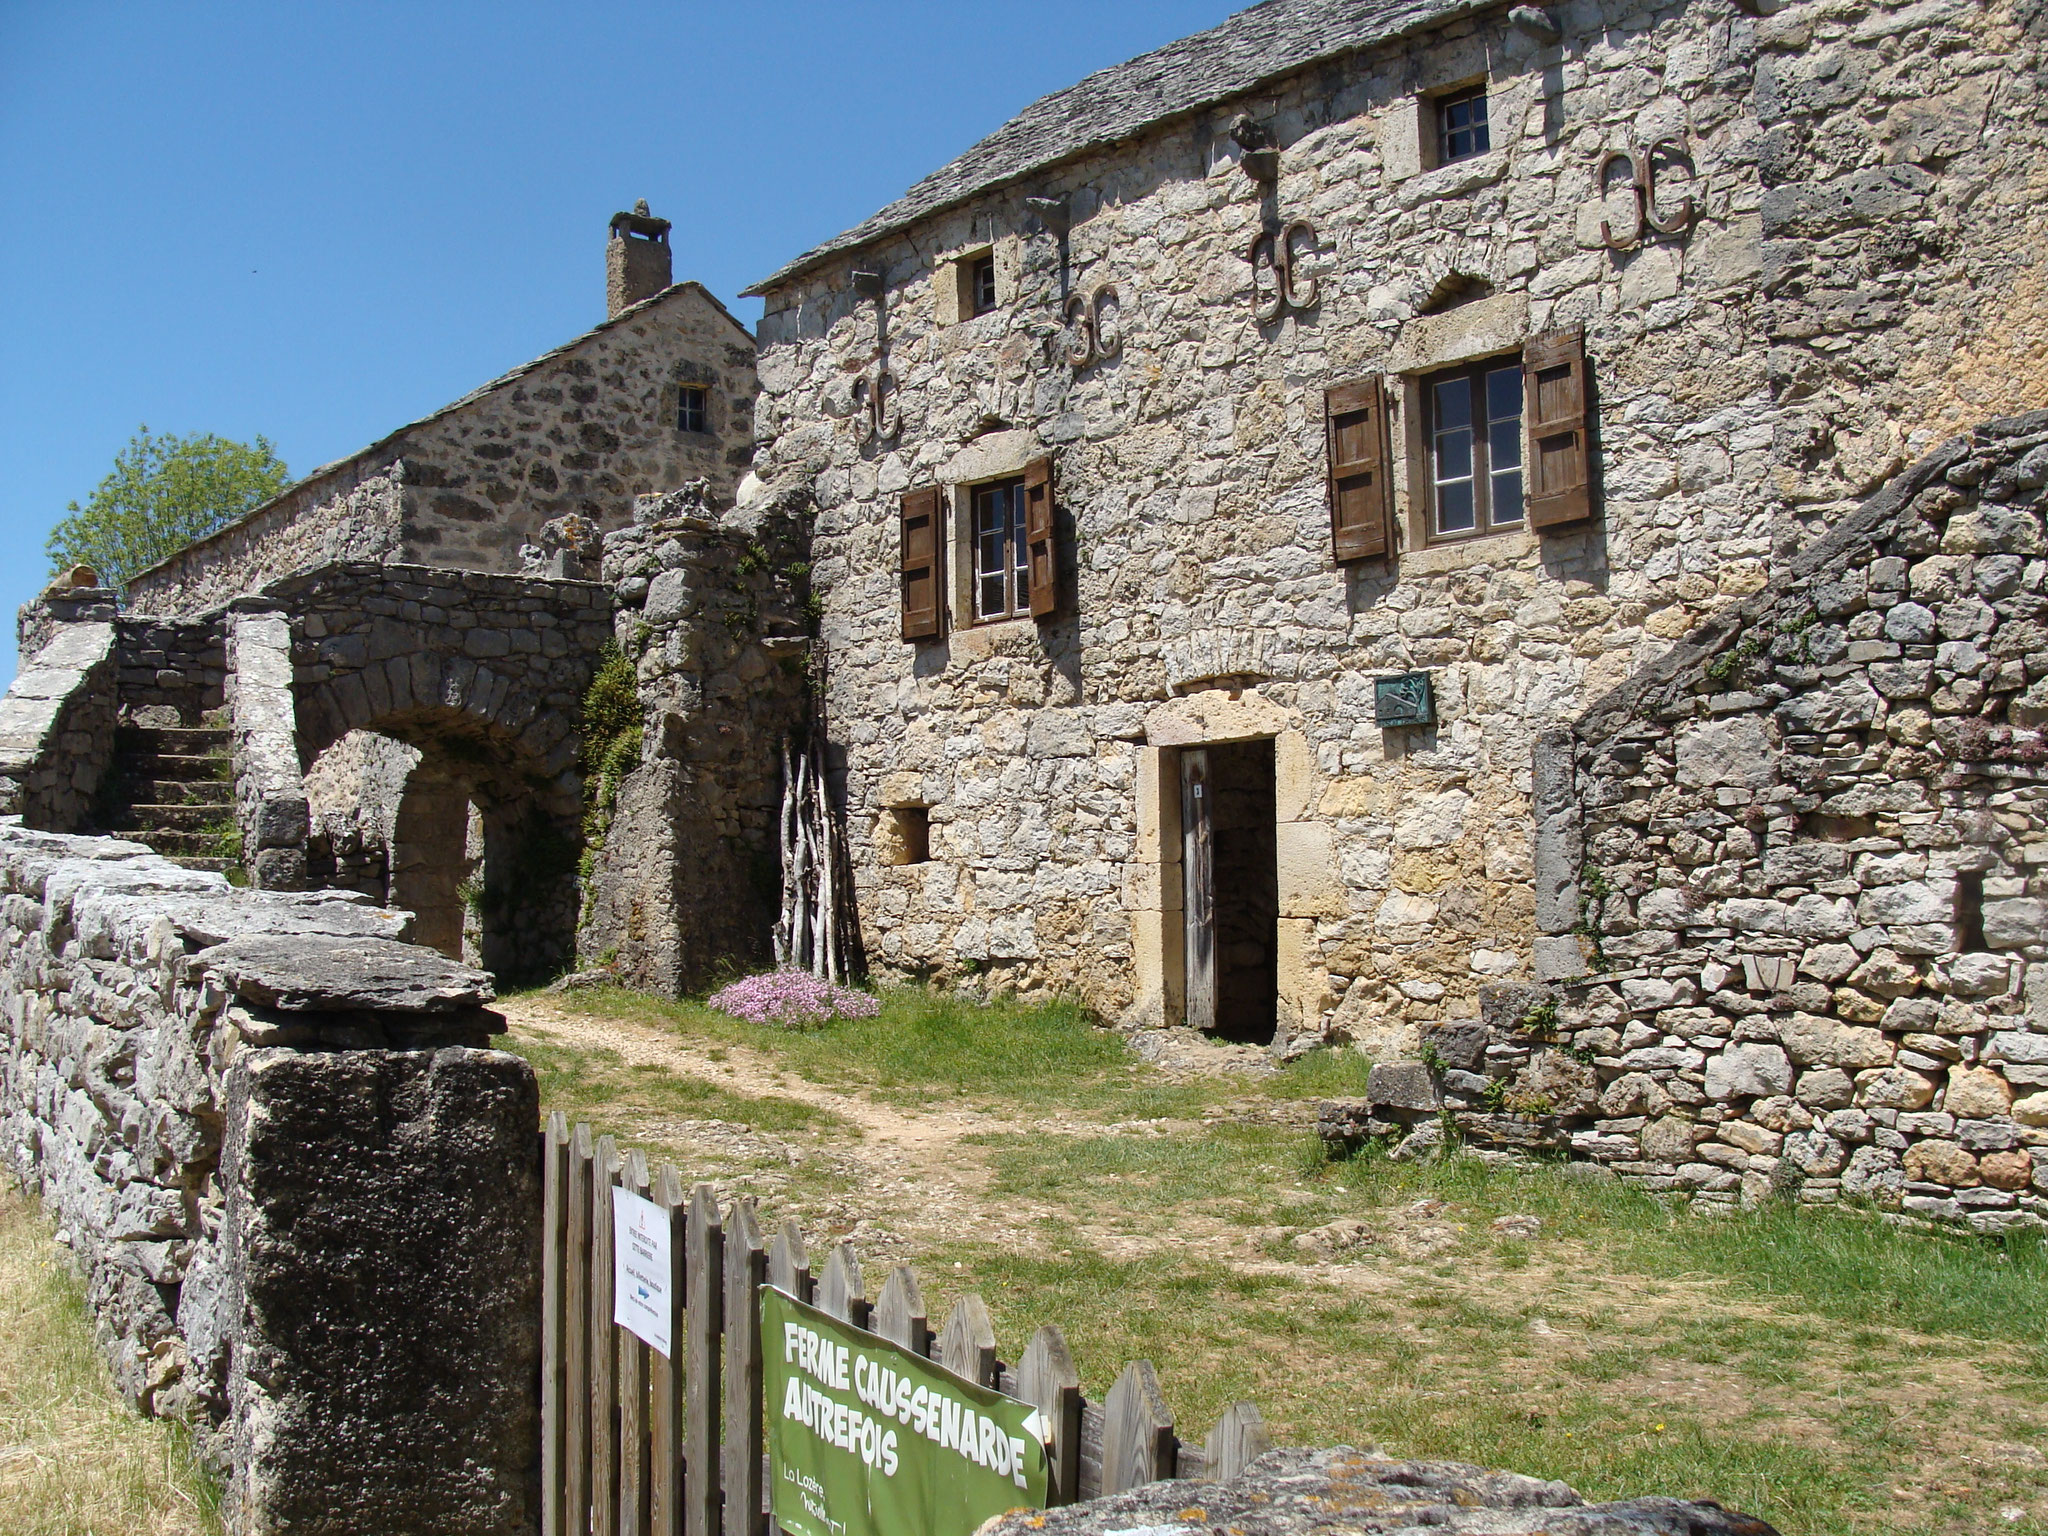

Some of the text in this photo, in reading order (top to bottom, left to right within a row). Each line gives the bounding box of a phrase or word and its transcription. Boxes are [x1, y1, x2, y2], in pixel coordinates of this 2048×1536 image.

[783, 1376, 899, 1477] AUTREFOIS
[784, 1322, 1028, 1489] FERME CAUSSENARDE
[783, 1462, 795, 1482] La
